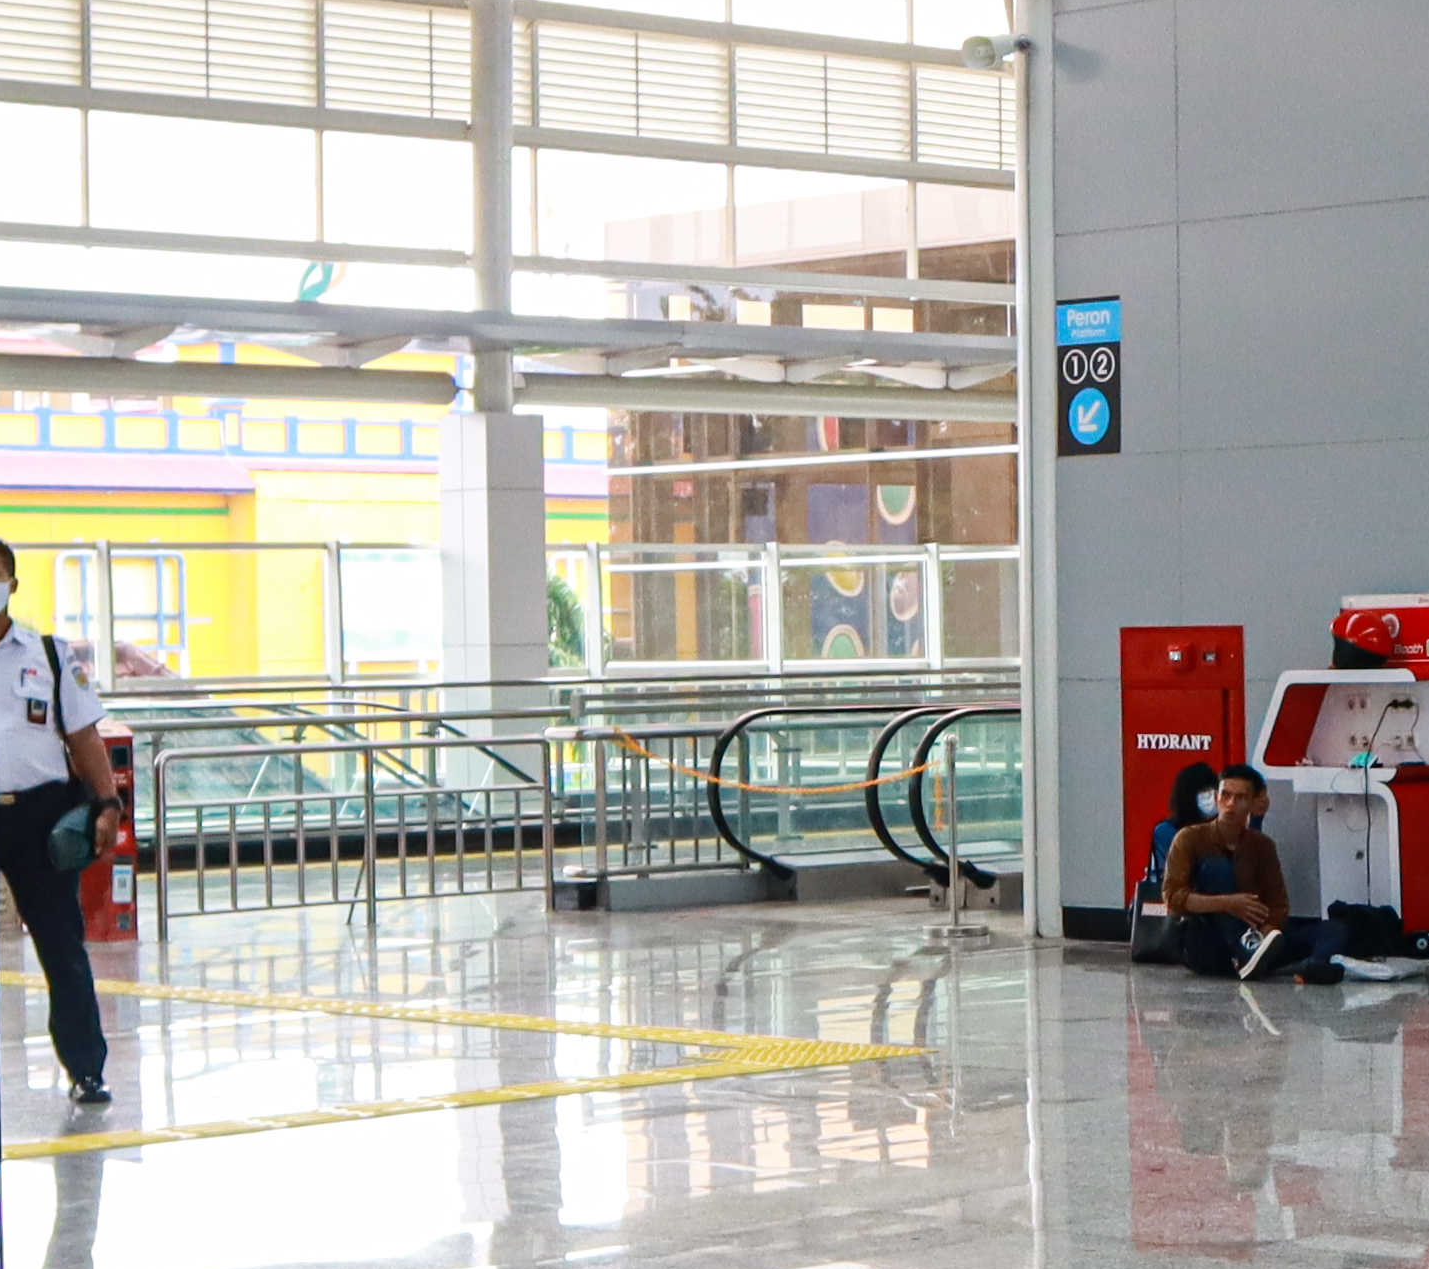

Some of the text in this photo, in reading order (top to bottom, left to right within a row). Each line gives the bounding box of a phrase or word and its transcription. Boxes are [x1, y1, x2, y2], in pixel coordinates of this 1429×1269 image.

[1067, 309, 1110, 327] Peron
[1071, 355, 1107, 377] 1 2
[1137, 734, 1211, 750] HYDRANT
